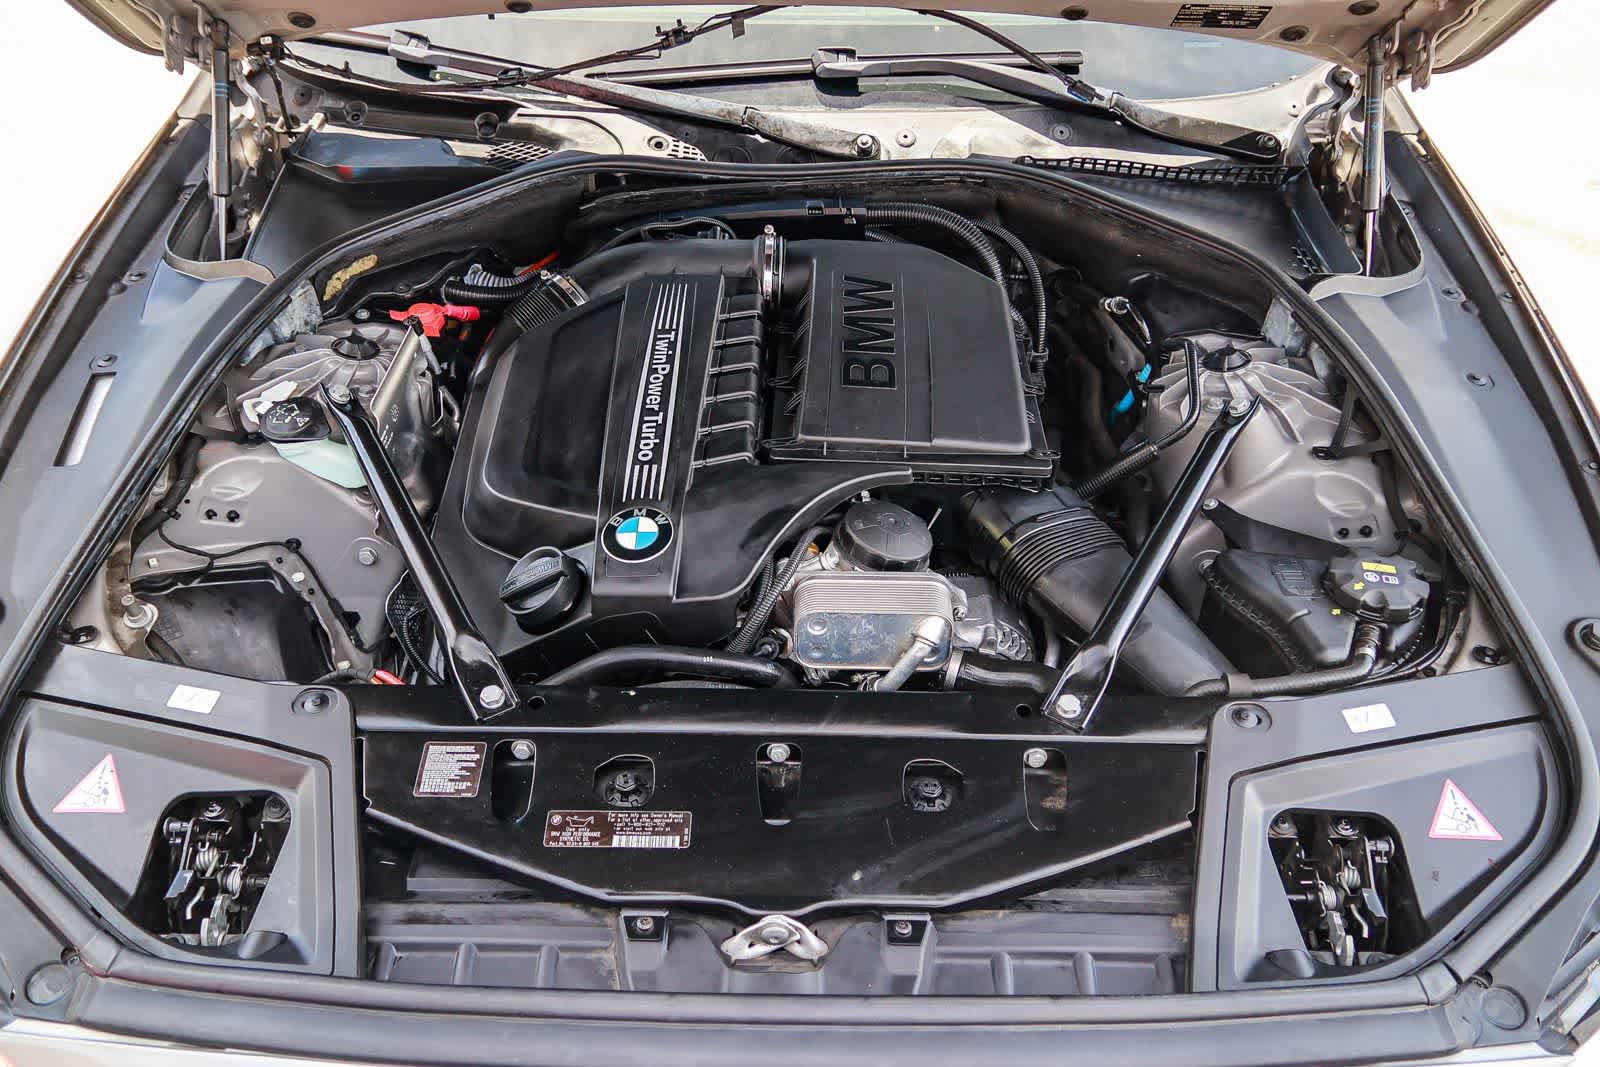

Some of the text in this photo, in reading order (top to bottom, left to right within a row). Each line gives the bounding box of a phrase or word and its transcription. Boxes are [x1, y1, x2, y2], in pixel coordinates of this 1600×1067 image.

[841, 273, 896, 390] BMW
[638, 330, 676, 462] TwinPower Turbo
[610, 508, 669, 527] BMW
